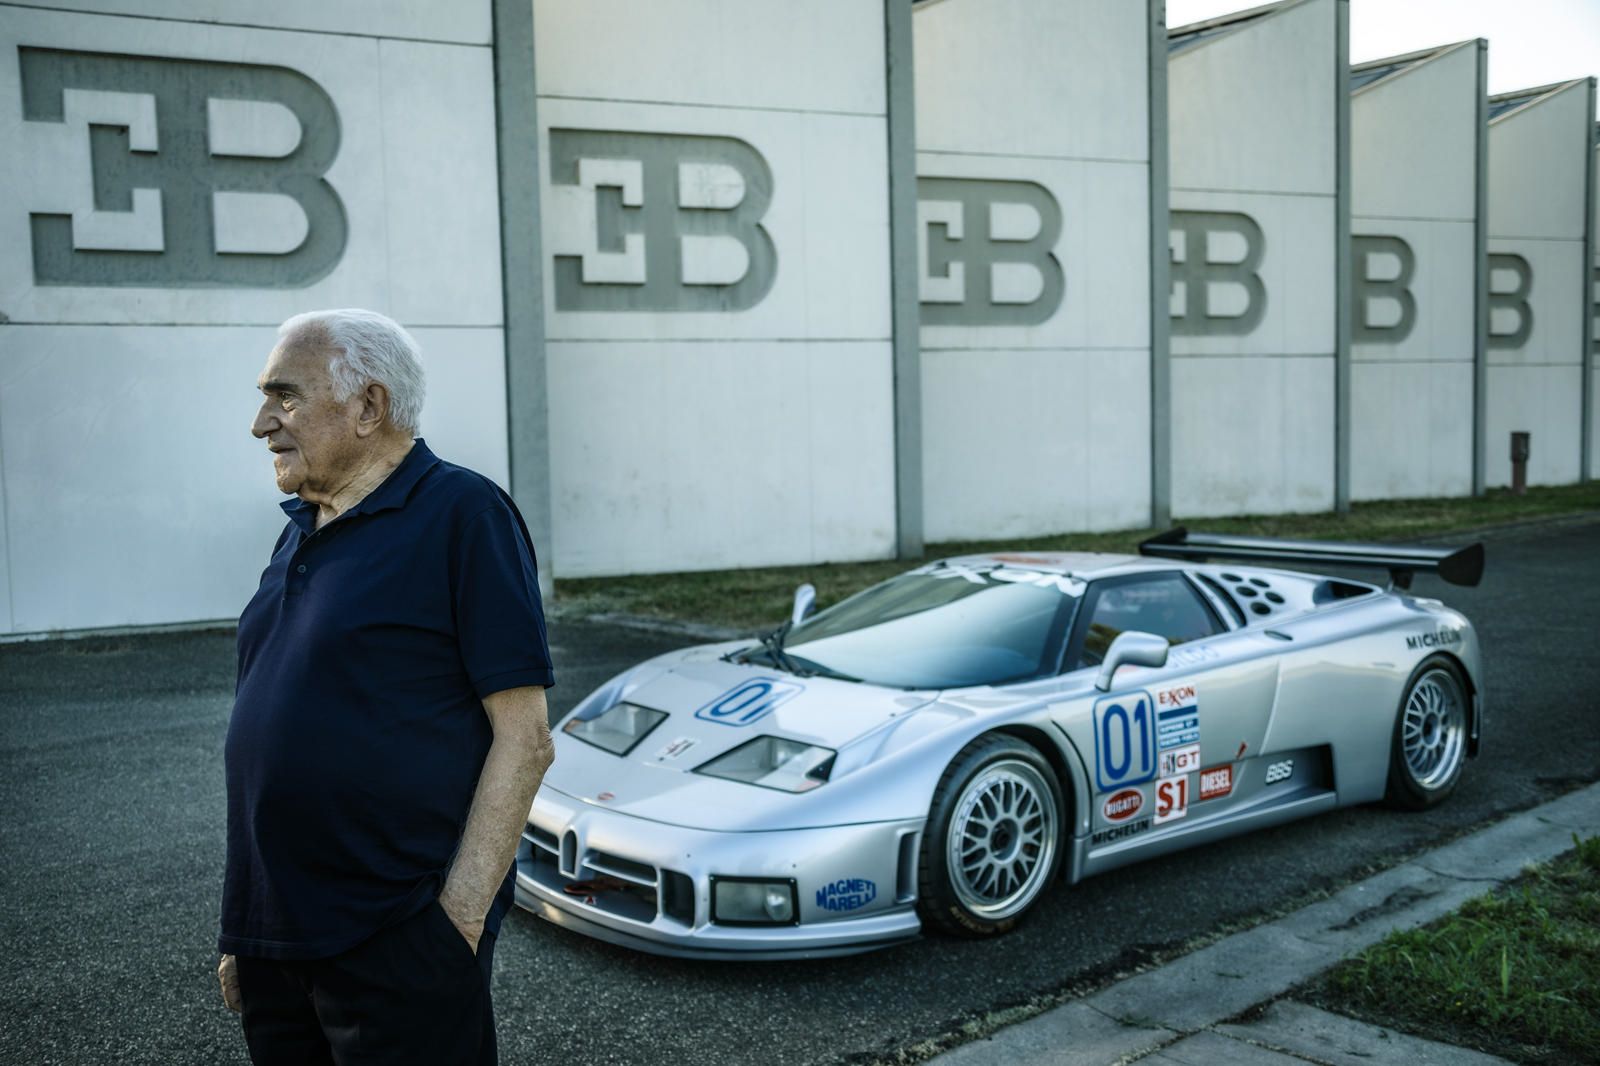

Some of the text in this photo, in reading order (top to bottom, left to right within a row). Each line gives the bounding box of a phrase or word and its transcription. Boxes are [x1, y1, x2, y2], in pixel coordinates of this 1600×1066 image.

[1406, 631, 1461, 649] MICHELIN
[1159, 686, 1195, 706] EXXON
[1102, 699, 1150, 780] 01
[1176, 751, 1199, 768] GT
[1201, 768, 1230, 793] DIESEL
[1265, 760, 1293, 784] BBS
[1158, 779, 1187, 817] S1
[1092, 820, 1150, 844] MICHELIN
